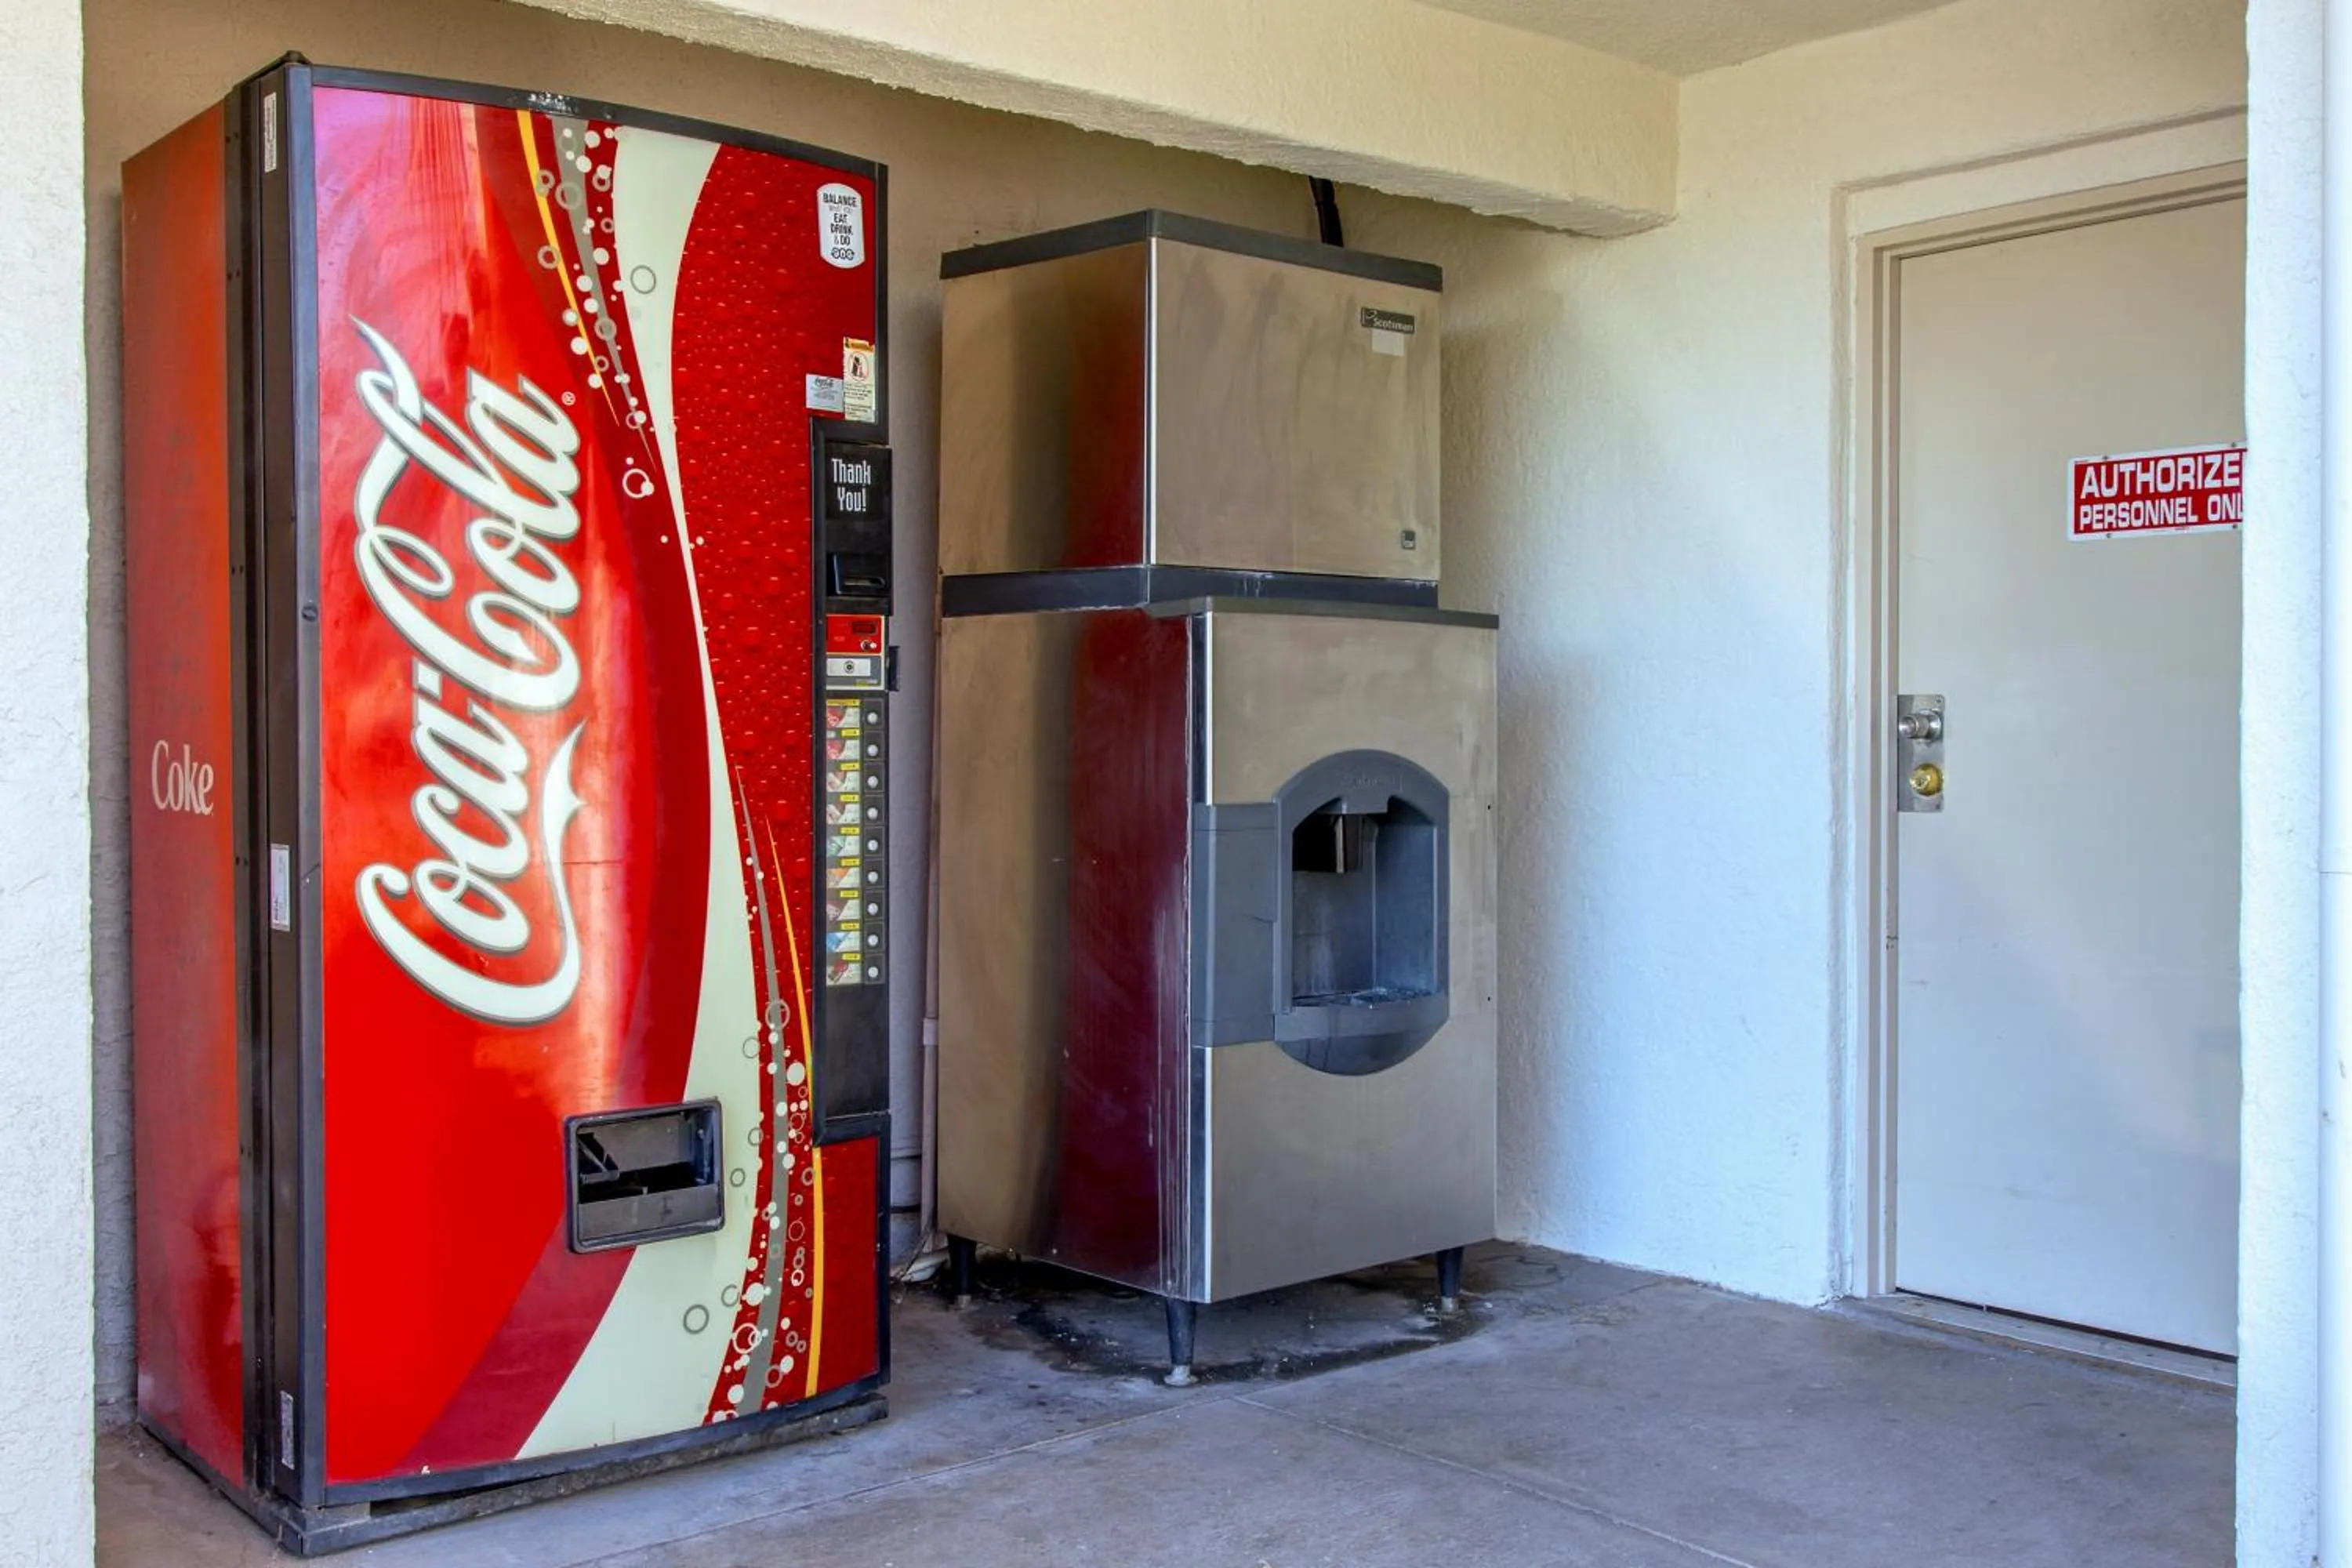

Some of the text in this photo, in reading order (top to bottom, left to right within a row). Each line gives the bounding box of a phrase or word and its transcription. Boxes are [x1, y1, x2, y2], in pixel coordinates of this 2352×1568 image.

[822, 193, 858, 207] BALANCE
[830, 223, 854, 235] DRINK
[833, 213, 848, 223] EAT
[840, 235, 851, 245] DO
[831, 458, 871, 485] Thank
[2080, 452, 2246, 499] AUTHORIZE
[837, 487, 866, 512] You!
[2080, 496, 2198, 531] PERSONNEL
[351, 314, 586, 1027] Coca-Cola
[151, 739, 214, 815] Coke
